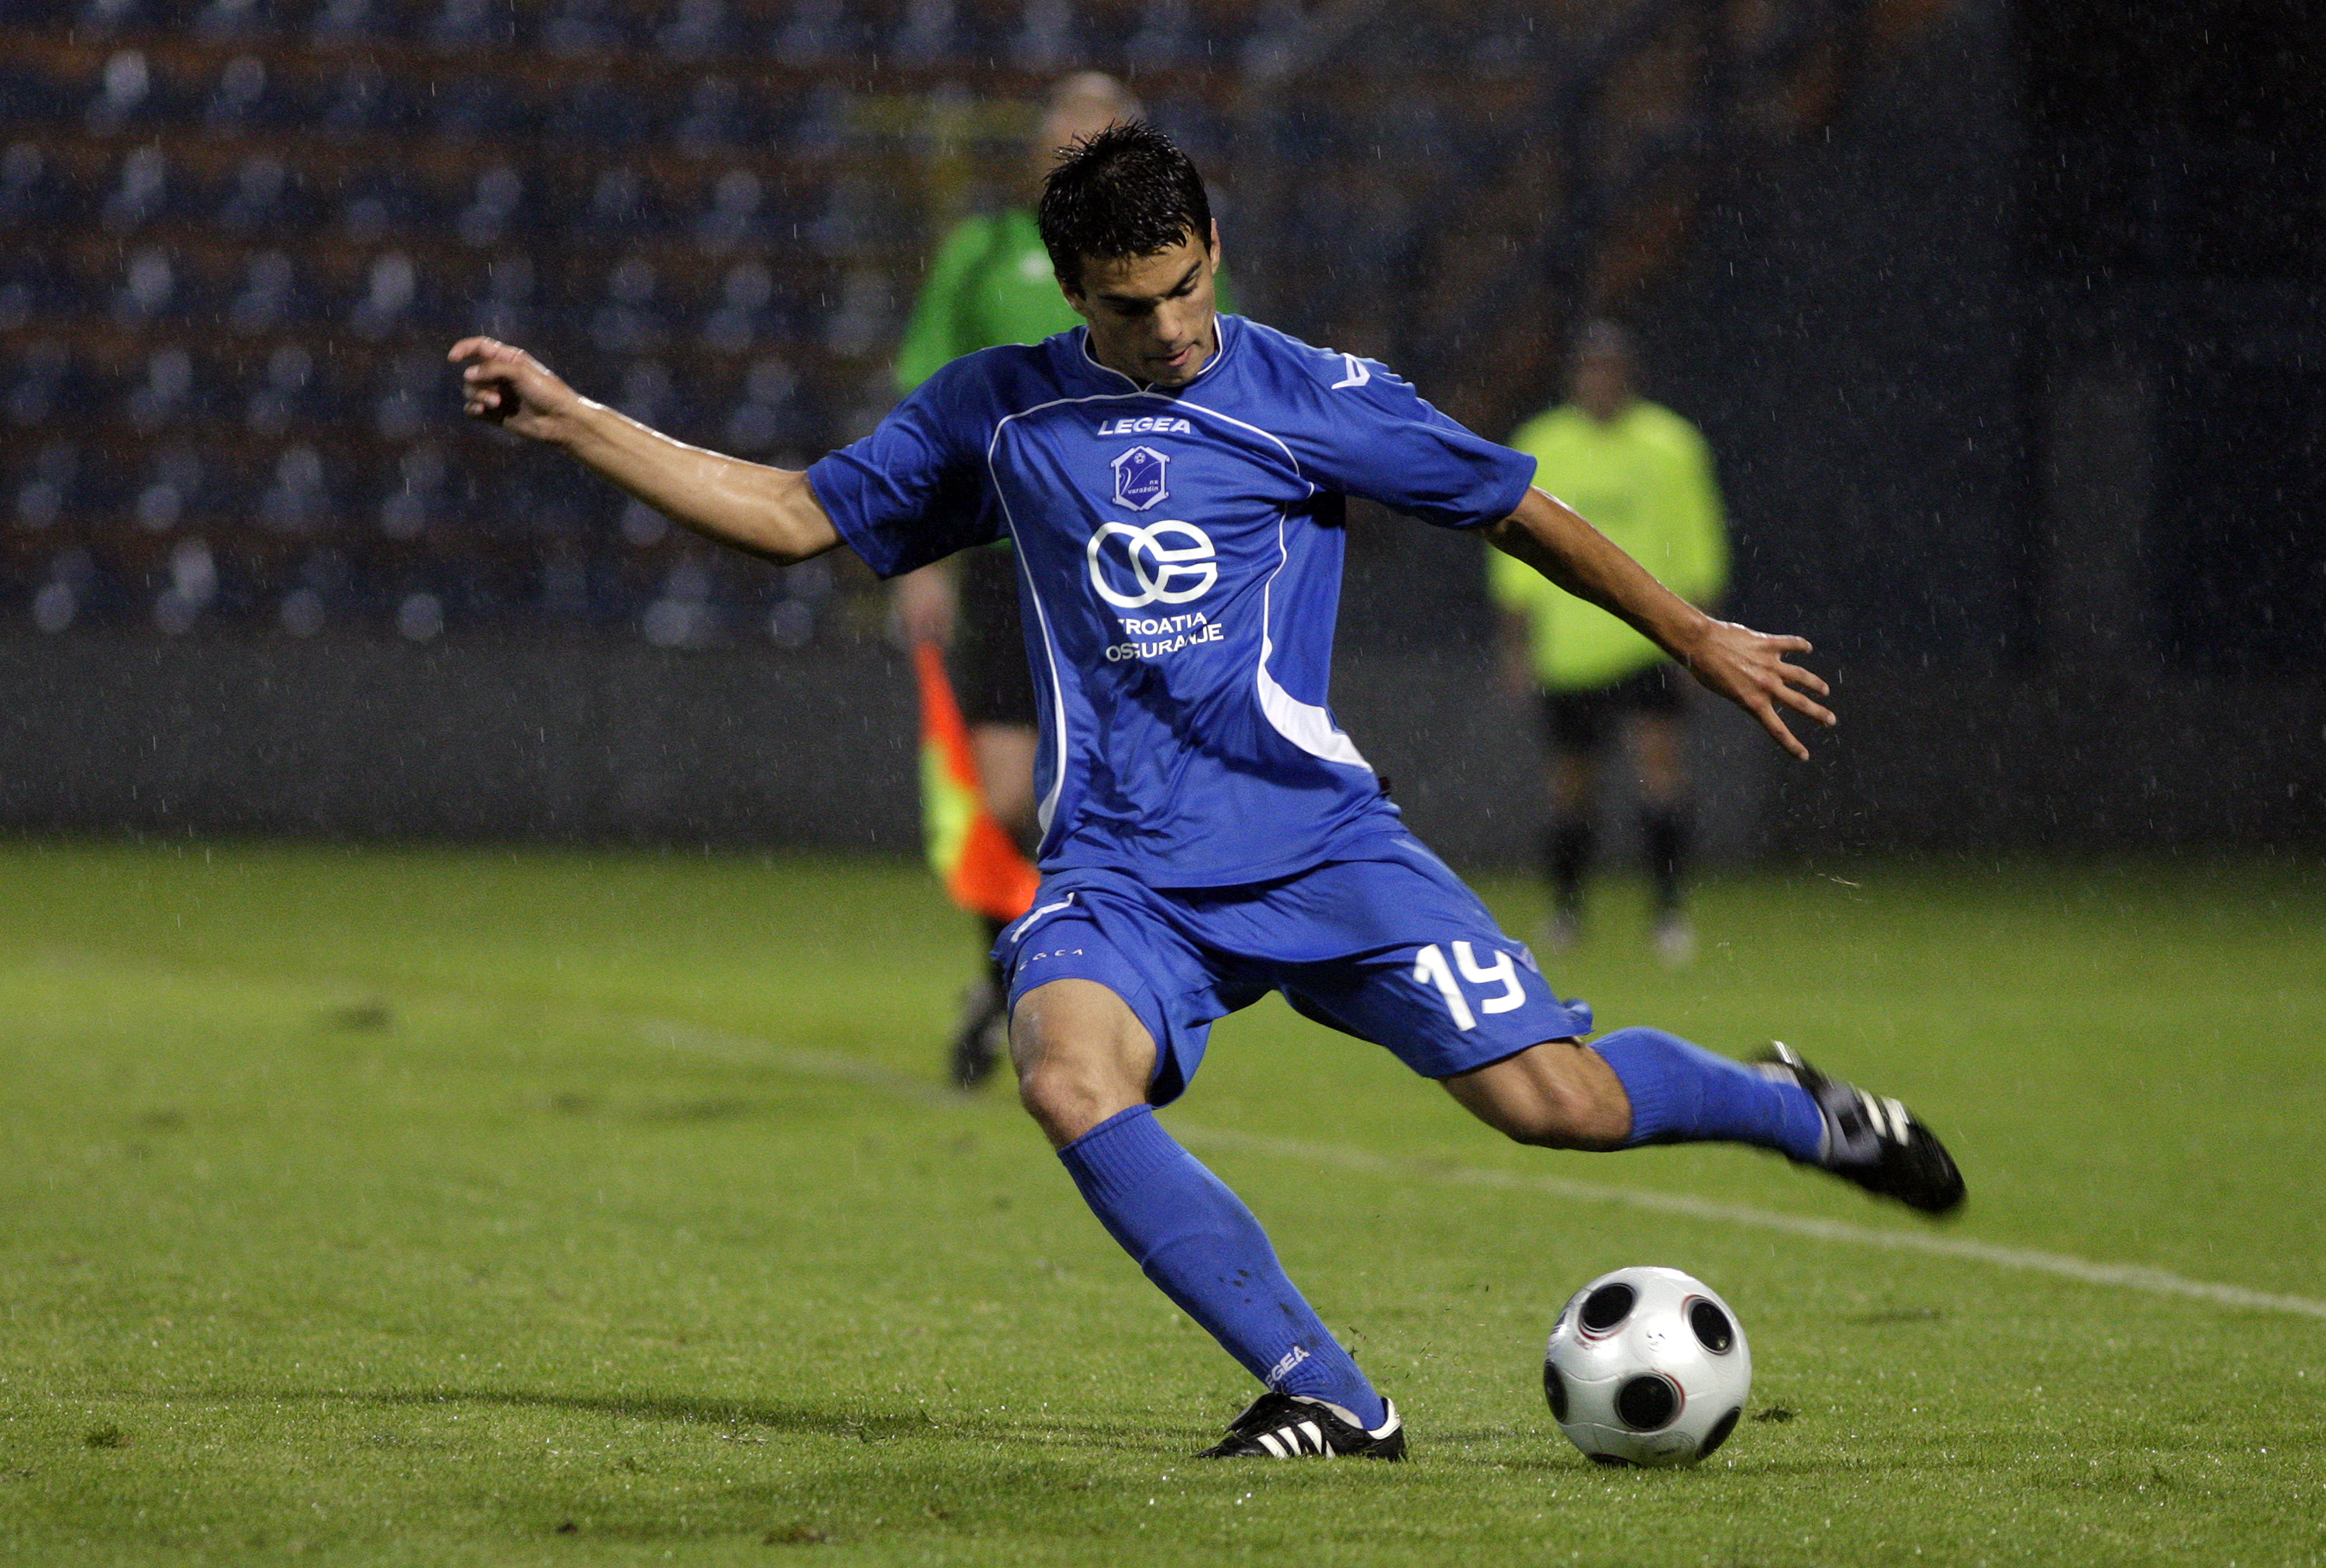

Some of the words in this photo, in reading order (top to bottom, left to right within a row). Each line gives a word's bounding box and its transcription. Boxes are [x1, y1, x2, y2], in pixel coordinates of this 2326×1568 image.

[1097, 417, 1191, 436] LEGEA
[1117, 612, 1208, 636] ROATIA
[1413, 940, 1527, 1032] 19
[1265, 1346, 1311, 1392] EGEA
